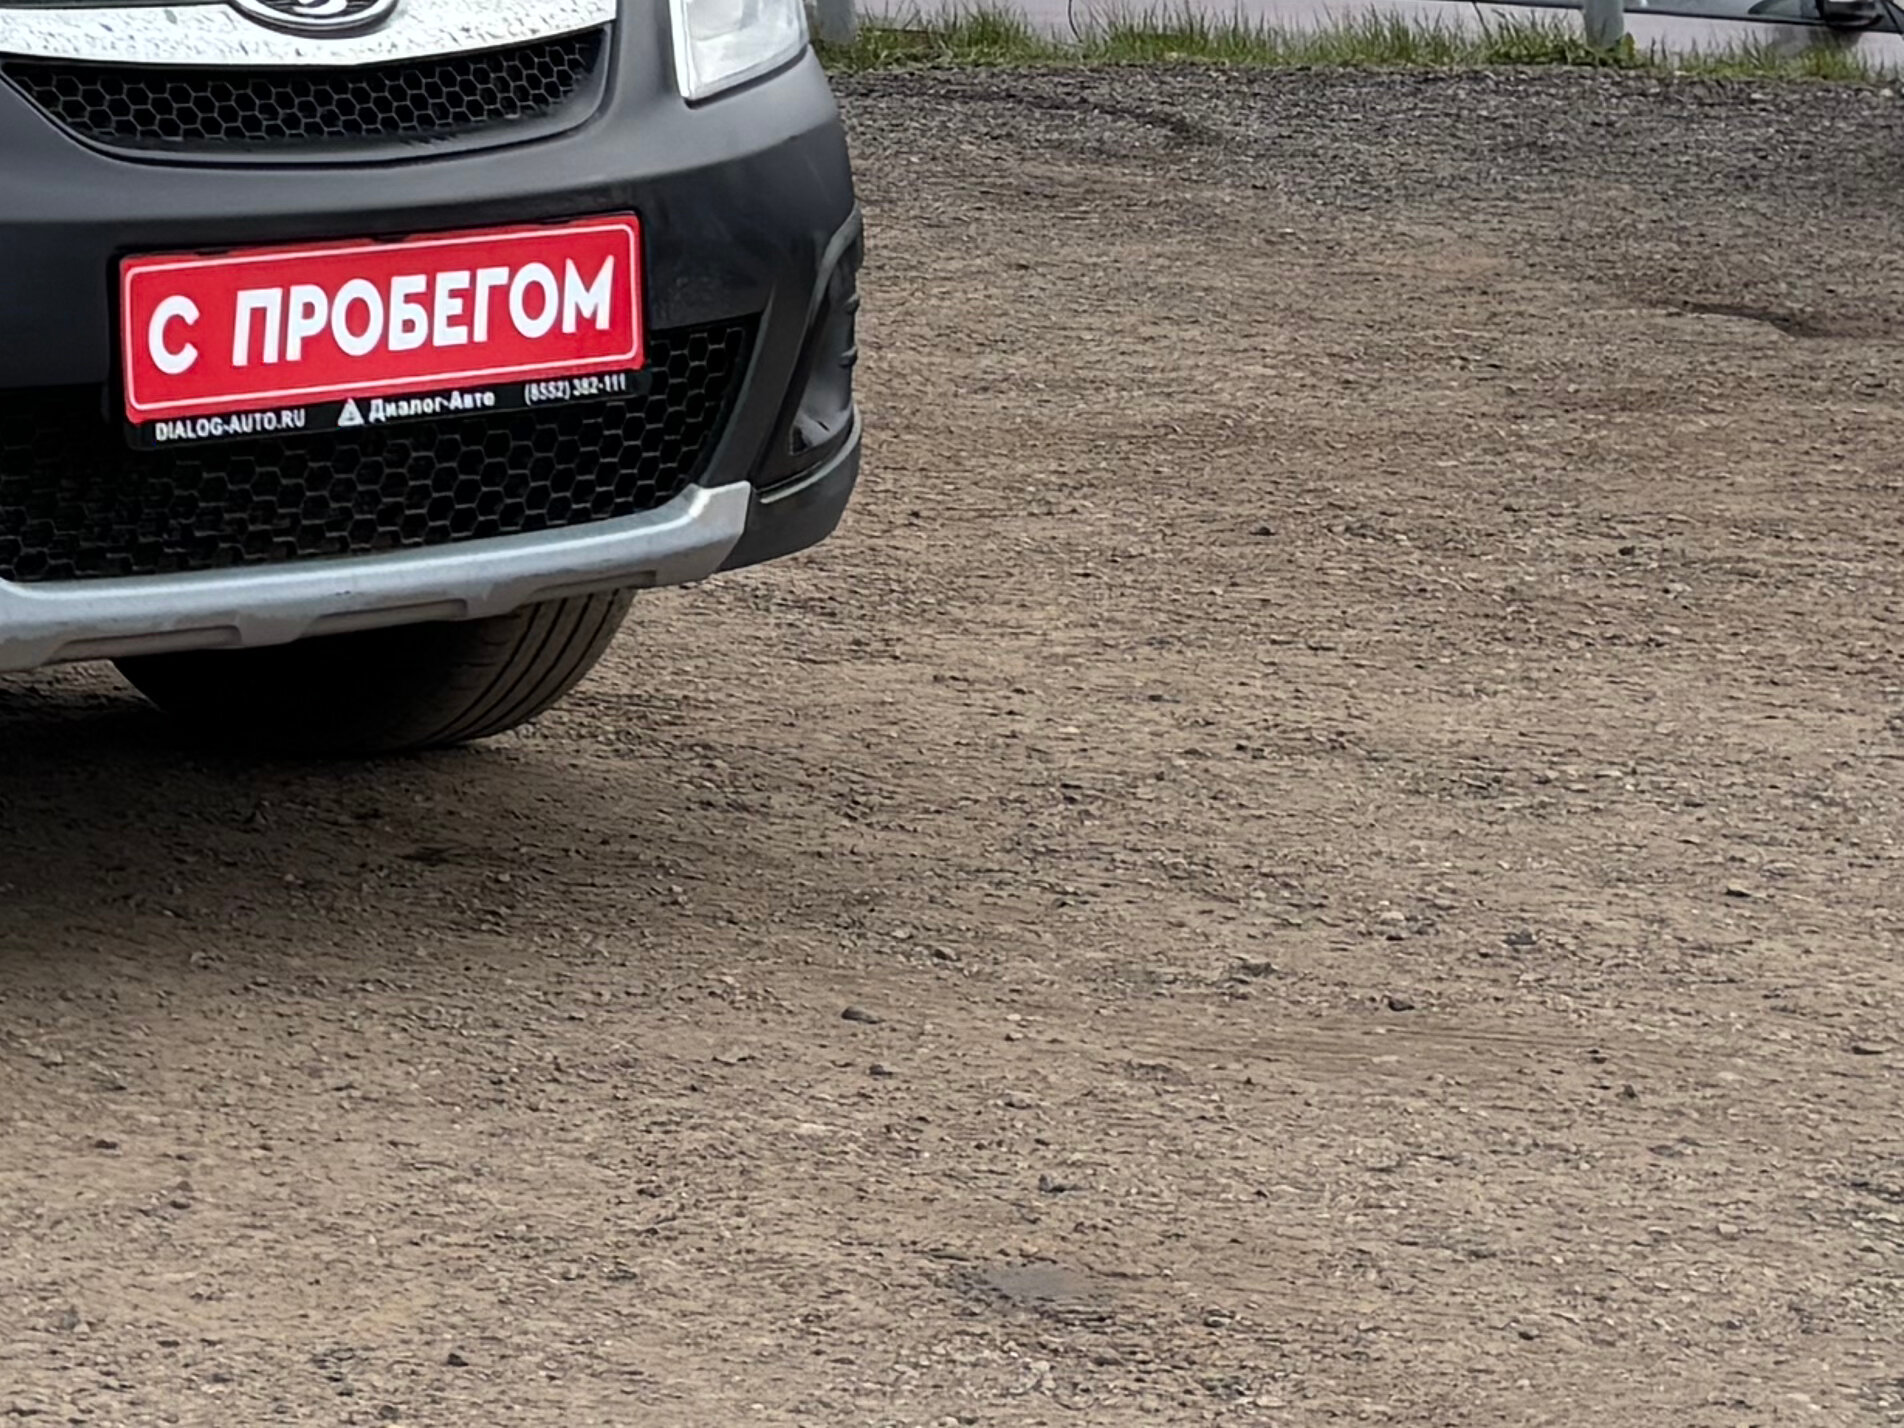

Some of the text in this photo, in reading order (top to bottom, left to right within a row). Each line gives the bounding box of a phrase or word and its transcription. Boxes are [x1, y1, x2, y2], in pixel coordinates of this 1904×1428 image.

[148, 254, 615, 374] С ПРОБЕГОМ
[368, 390, 496, 424] Диалог-Авто
[154, 408, 306, 442] DIALOG-AUTO.RU
